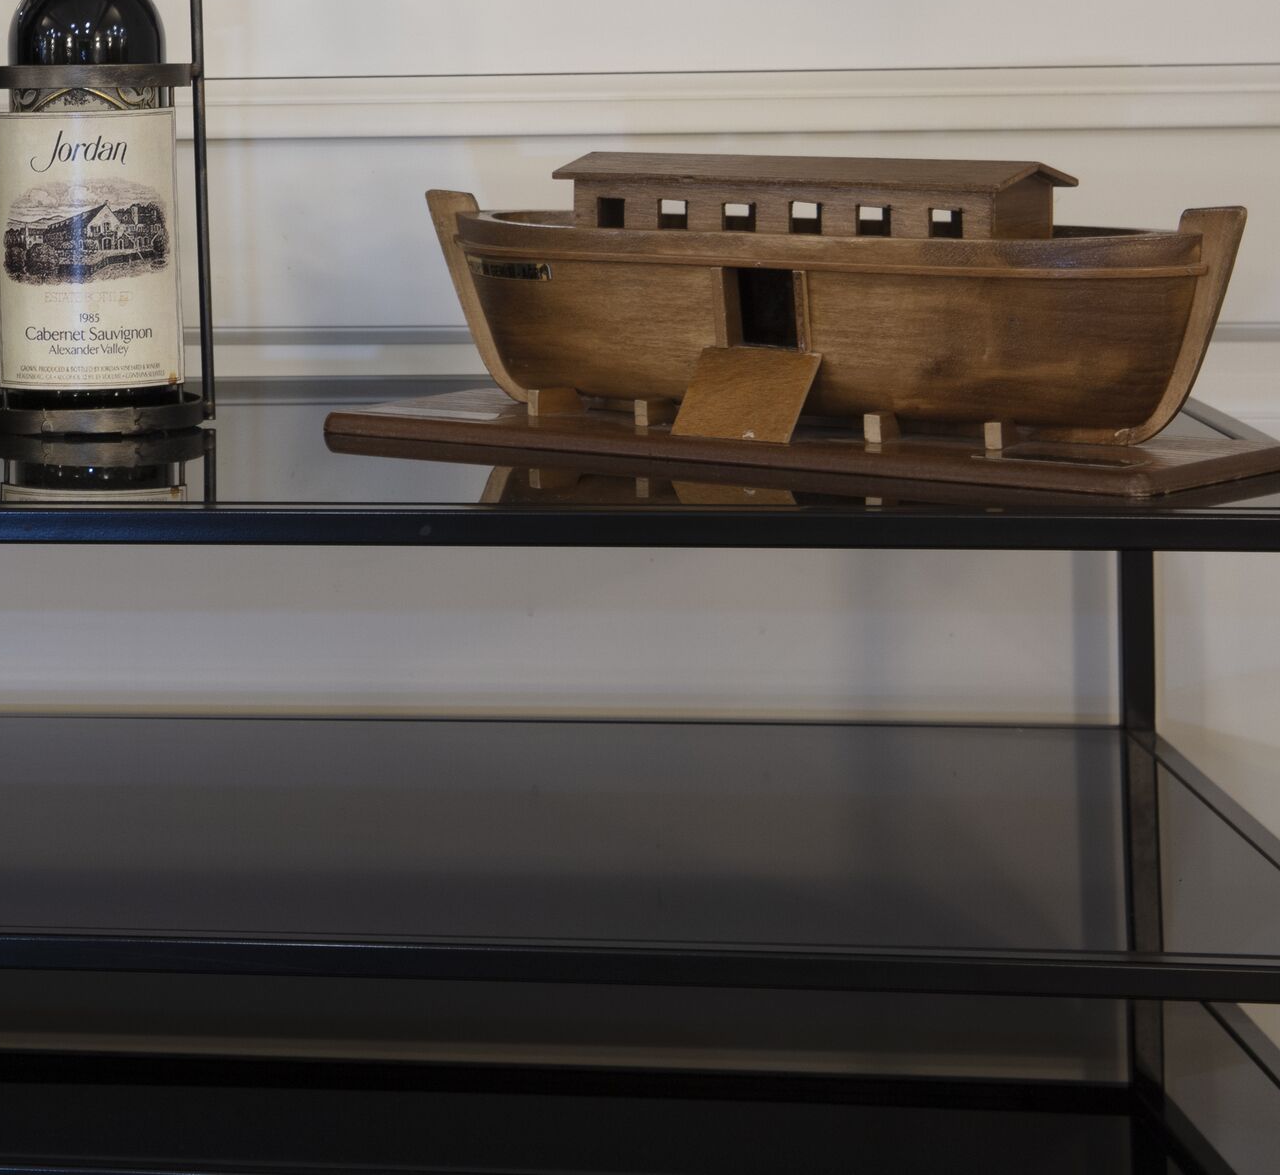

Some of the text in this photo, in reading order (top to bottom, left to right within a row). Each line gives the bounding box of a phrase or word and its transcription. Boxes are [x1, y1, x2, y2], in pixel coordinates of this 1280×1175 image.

[30, 130, 127, 173] Jordan
[79, 313, 100, 323] 1985
[25, 325, 153, 344] Cabernet Sauvignon
[48, 343, 129, 357] Alexander Valley
